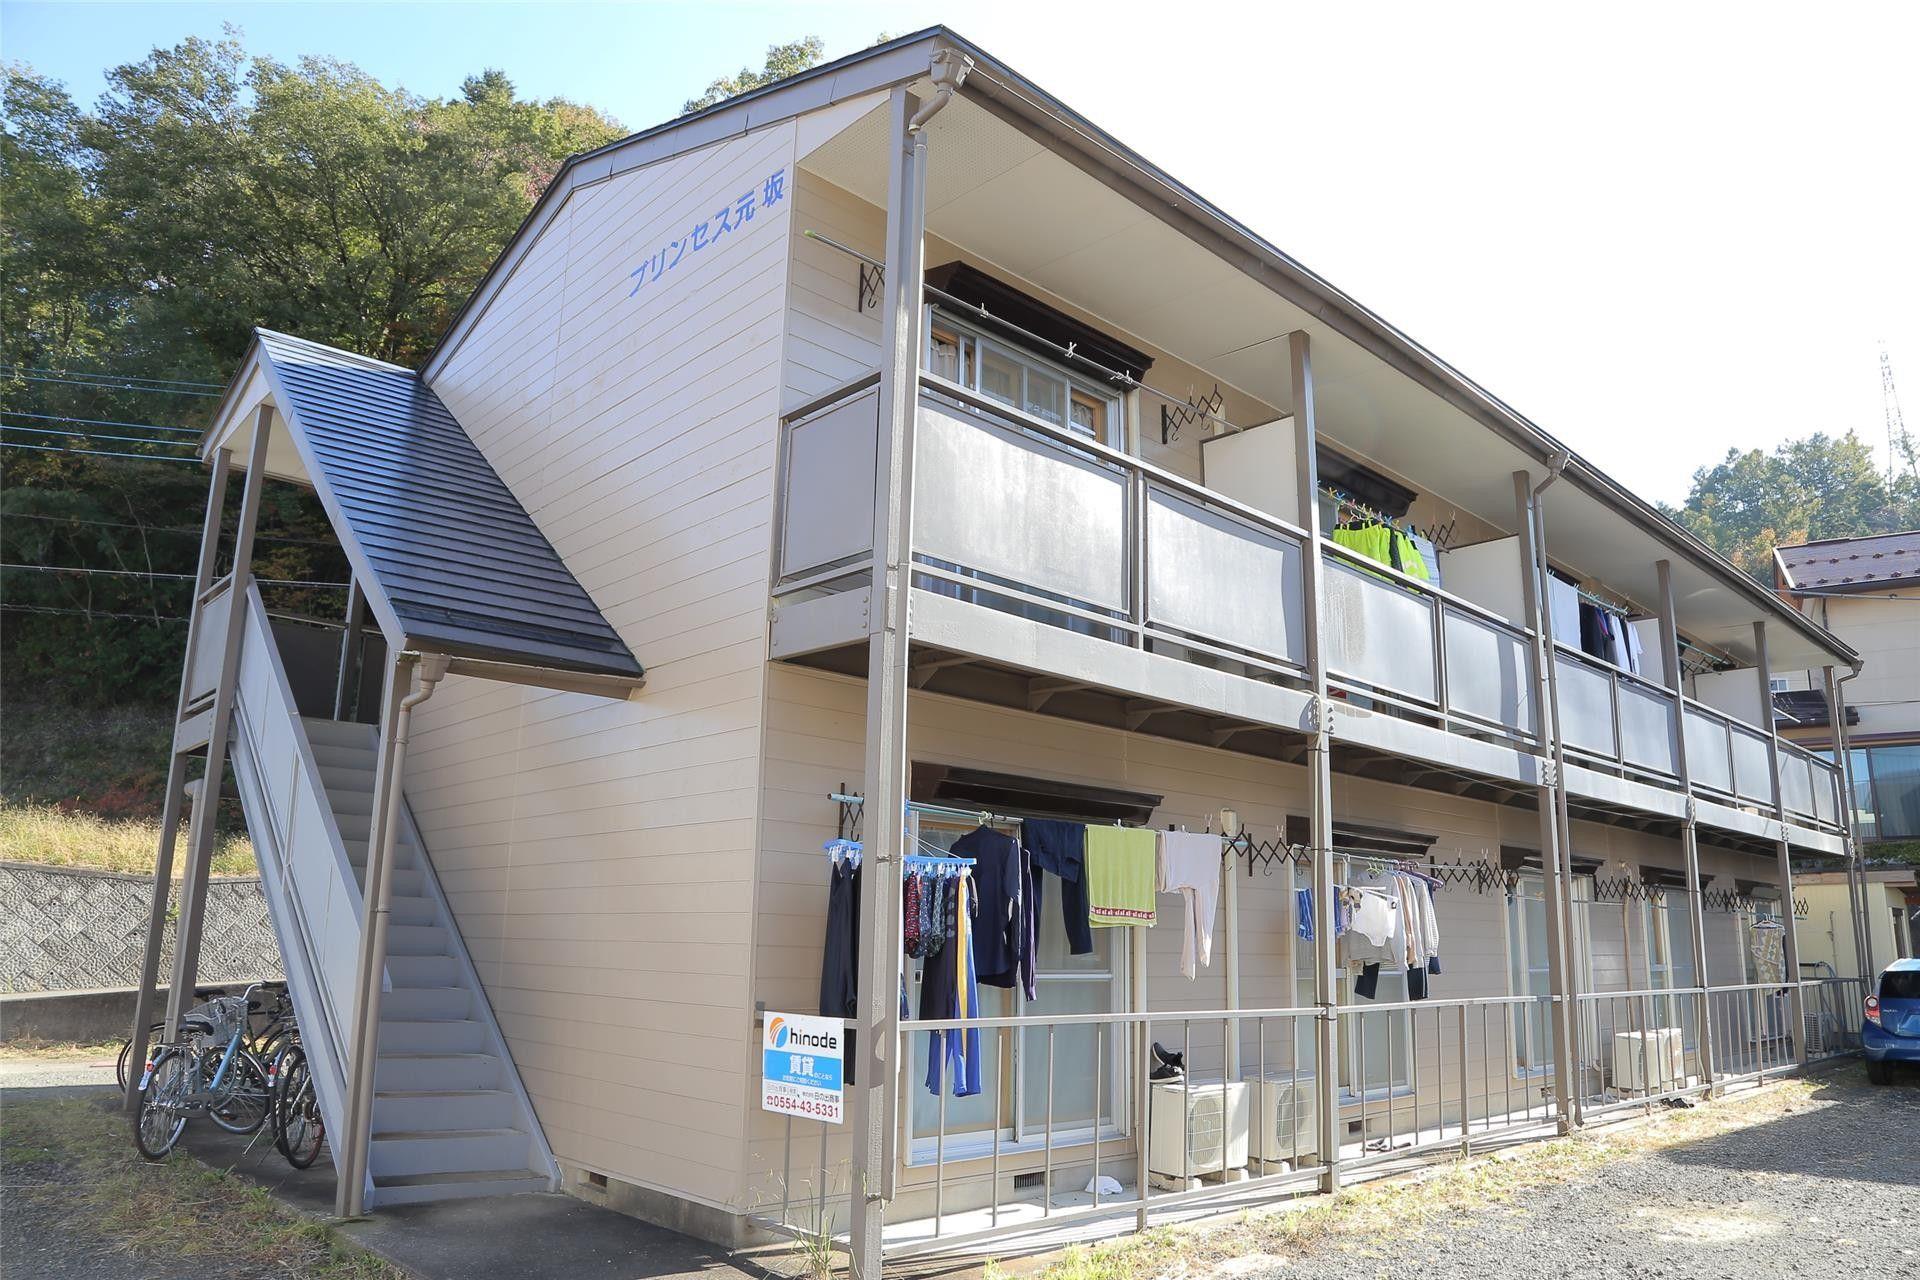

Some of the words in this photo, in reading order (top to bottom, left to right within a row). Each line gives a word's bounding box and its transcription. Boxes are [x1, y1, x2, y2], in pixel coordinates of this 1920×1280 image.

[630, 168, 785, 298] プリンセス元坂
[790, 1027, 837, 1049] hinode
[774, 1095, 838, 1118] 0554-43-5331
